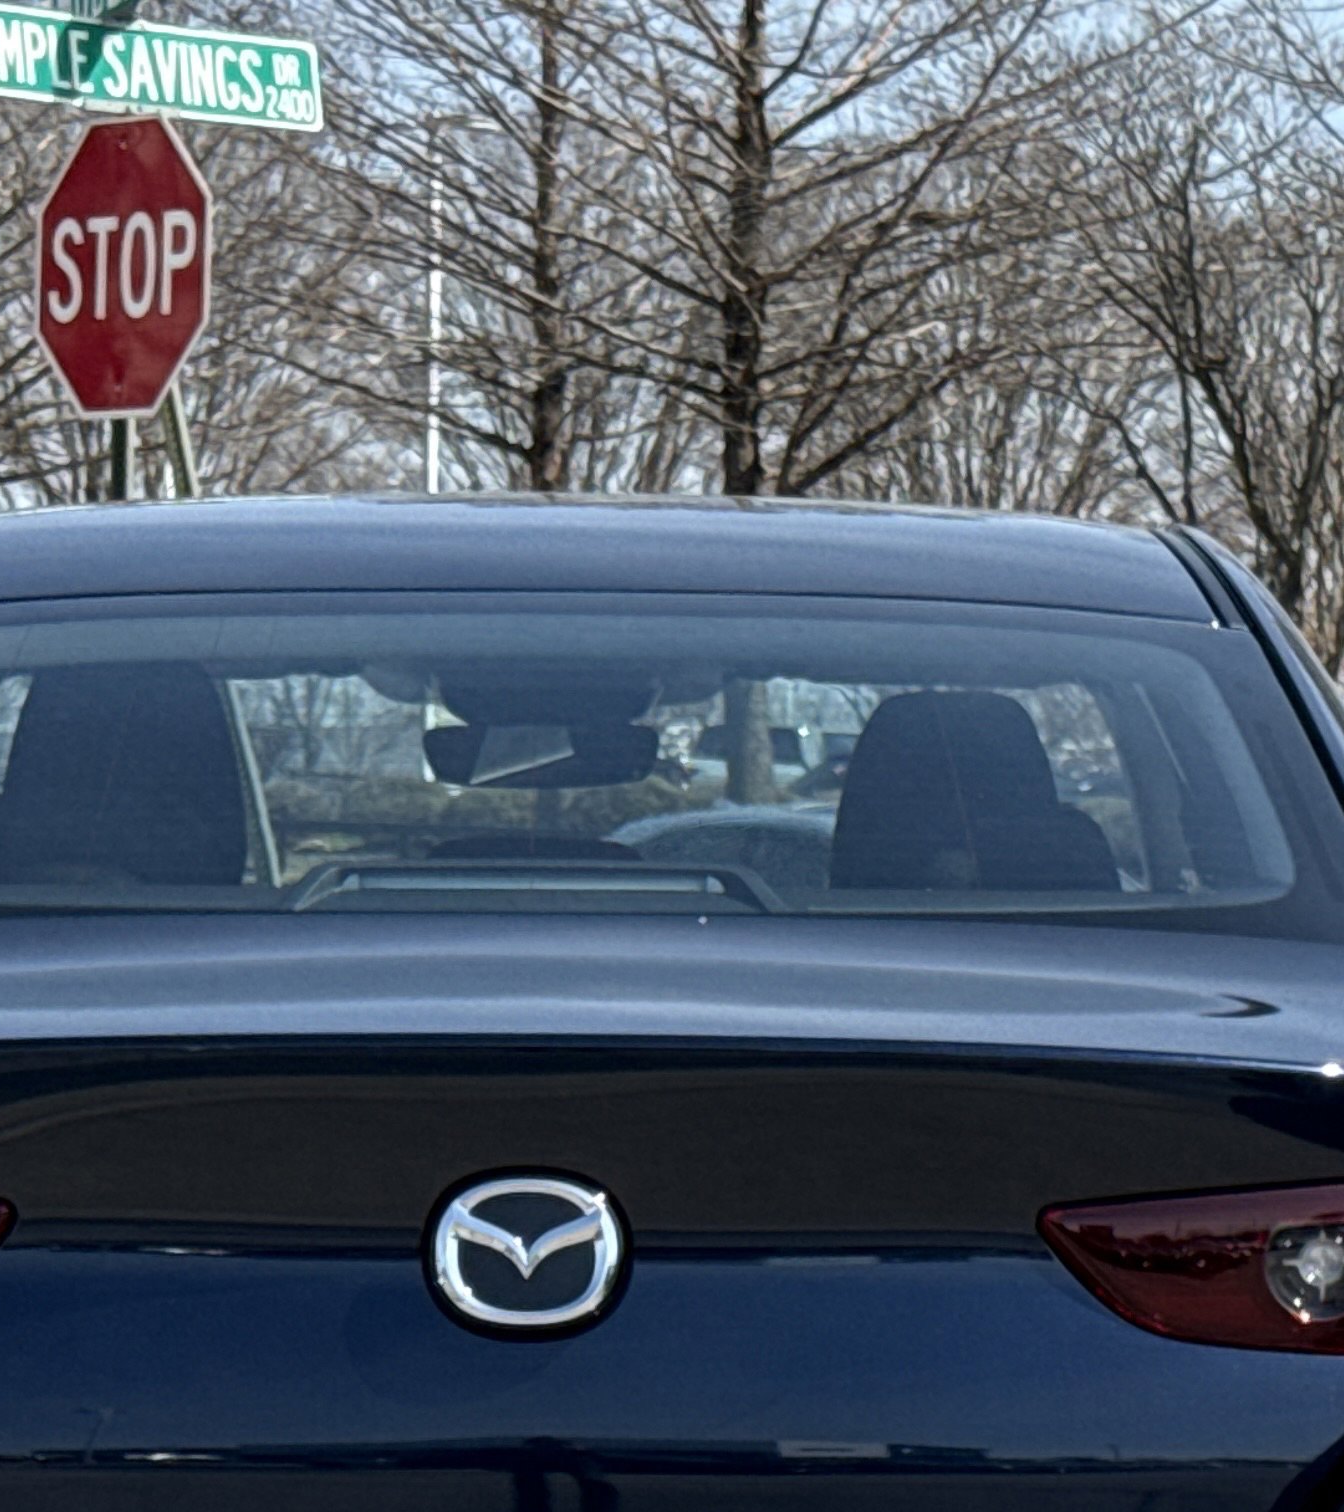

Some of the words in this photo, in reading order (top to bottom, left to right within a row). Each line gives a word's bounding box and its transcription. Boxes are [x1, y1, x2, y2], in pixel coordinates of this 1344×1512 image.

[102, 32, 264, 113] SAVINGS
[273, 53, 302, 87] DR
[265, 87, 316, 123] 2400
[48, 208, 197, 325] STOP
